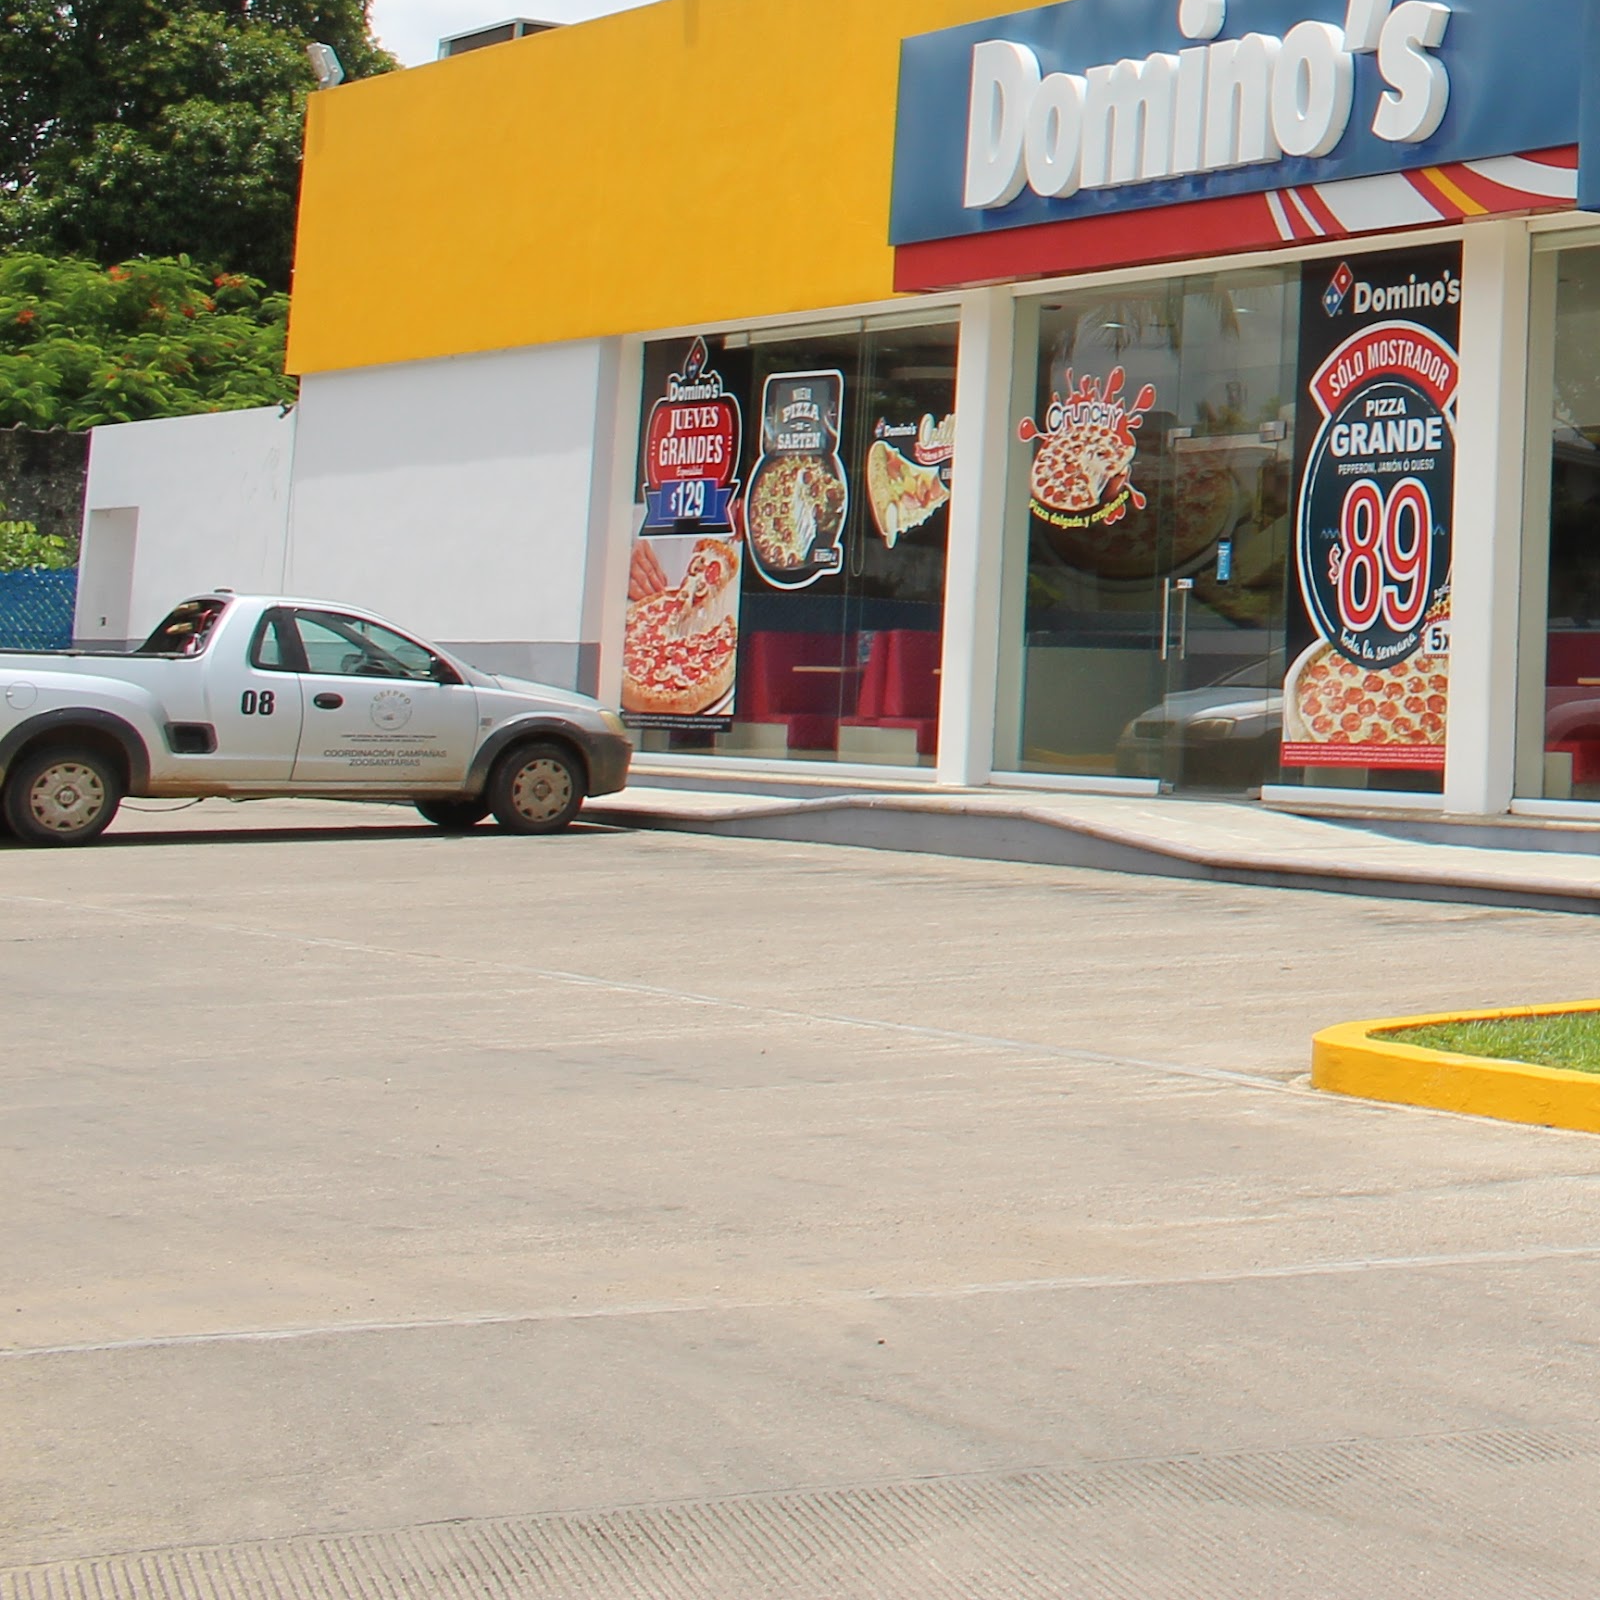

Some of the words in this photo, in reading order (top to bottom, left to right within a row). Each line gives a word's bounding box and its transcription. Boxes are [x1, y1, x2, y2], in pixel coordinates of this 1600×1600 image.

[1353, 269, 1461, 314] Domino's
[1329, 351, 1364, 398] SÓLO
[1367, 339, 1450, 391] MOSTRADOR
[669, 378, 720, 403] Domino's
[667, 406, 720, 438] JUEVES
[782, 402, 820, 423] PIZZA
[1366, 397, 1407, 418] PIZZA
[659, 435, 724, 467] GRANDES
[1330, 416, 1443, 458] GRANDE
[1411, 457, 1435, 471] QUESO
[670, 480, 706, 518] $129
[1029, 498, 1050, 520] Pizza
[1340, 626, 1361, 655] Toda
[1362, 635, 1375, 660] la
[1376, 632, 1418, 660] semana
[241, 690, 275, 716] 08
[349, 758, 420, 767] ZOOSANITARIAS
